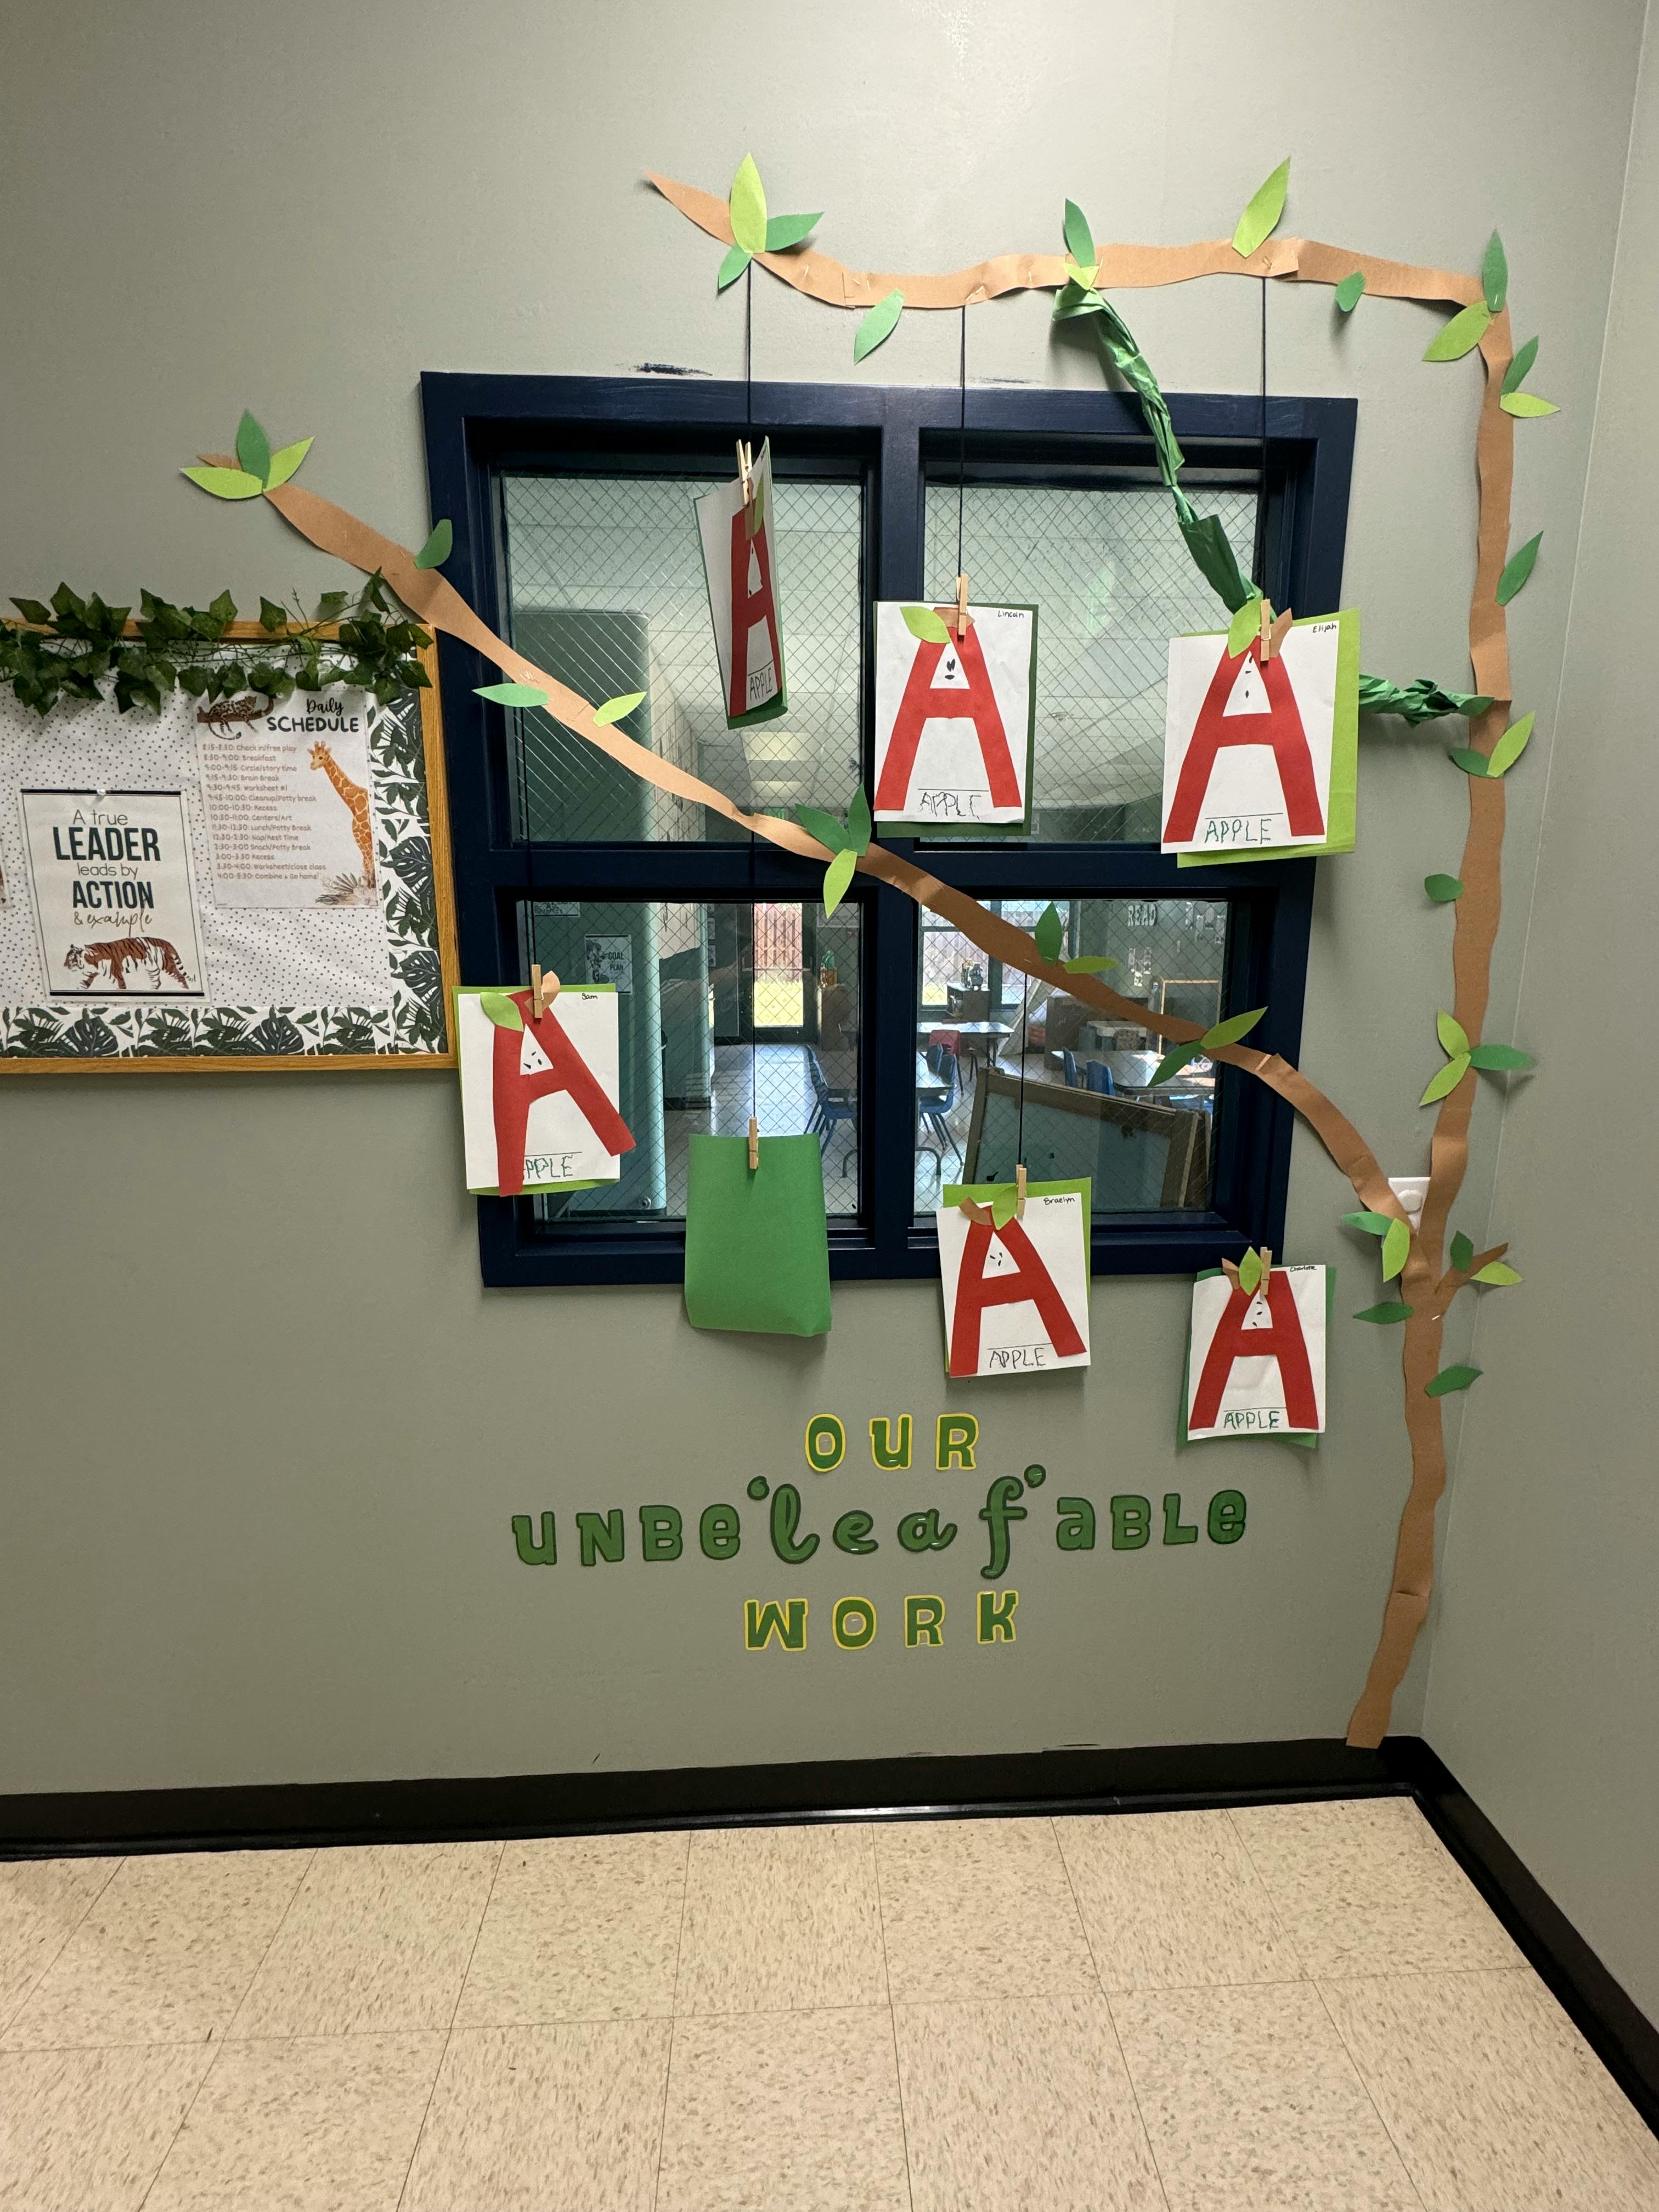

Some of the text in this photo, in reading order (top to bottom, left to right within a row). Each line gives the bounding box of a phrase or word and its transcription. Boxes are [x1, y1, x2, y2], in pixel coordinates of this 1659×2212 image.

[998, 610, 1024, 618] Lincoln
[1312, 623, 1336, 633] Elijah
[750, 667, 772, 701] APPLE
[306, 697, 344, 716] Daily
[267, 716, 359, 732] SCHEDULE
[282, 745, 297, 753] play
[72, 809, 128, 826] A true
[1204, 819, 1272, 844] APPLE
[53, 826, 161, 861] LEADER
[77, 863, 138, 880] leads by
[72, 881, 154, 909] ACTION
[74, 898, 153, 938] & example
[1128, 904, 1158, 927] READ
[582, 992, 598, 1000] Sam
[523, 1155, 573, 1180] PPLE
[1043, 1197, 1075, 1205] Braelyn
[990, 1347, 1046, 1369] APPLE
[1223, 1411, 1280, 1429] APPLE
[805, 1413, 979, 1472] OUR
[744, 1590, 1019, 1650] WORK
